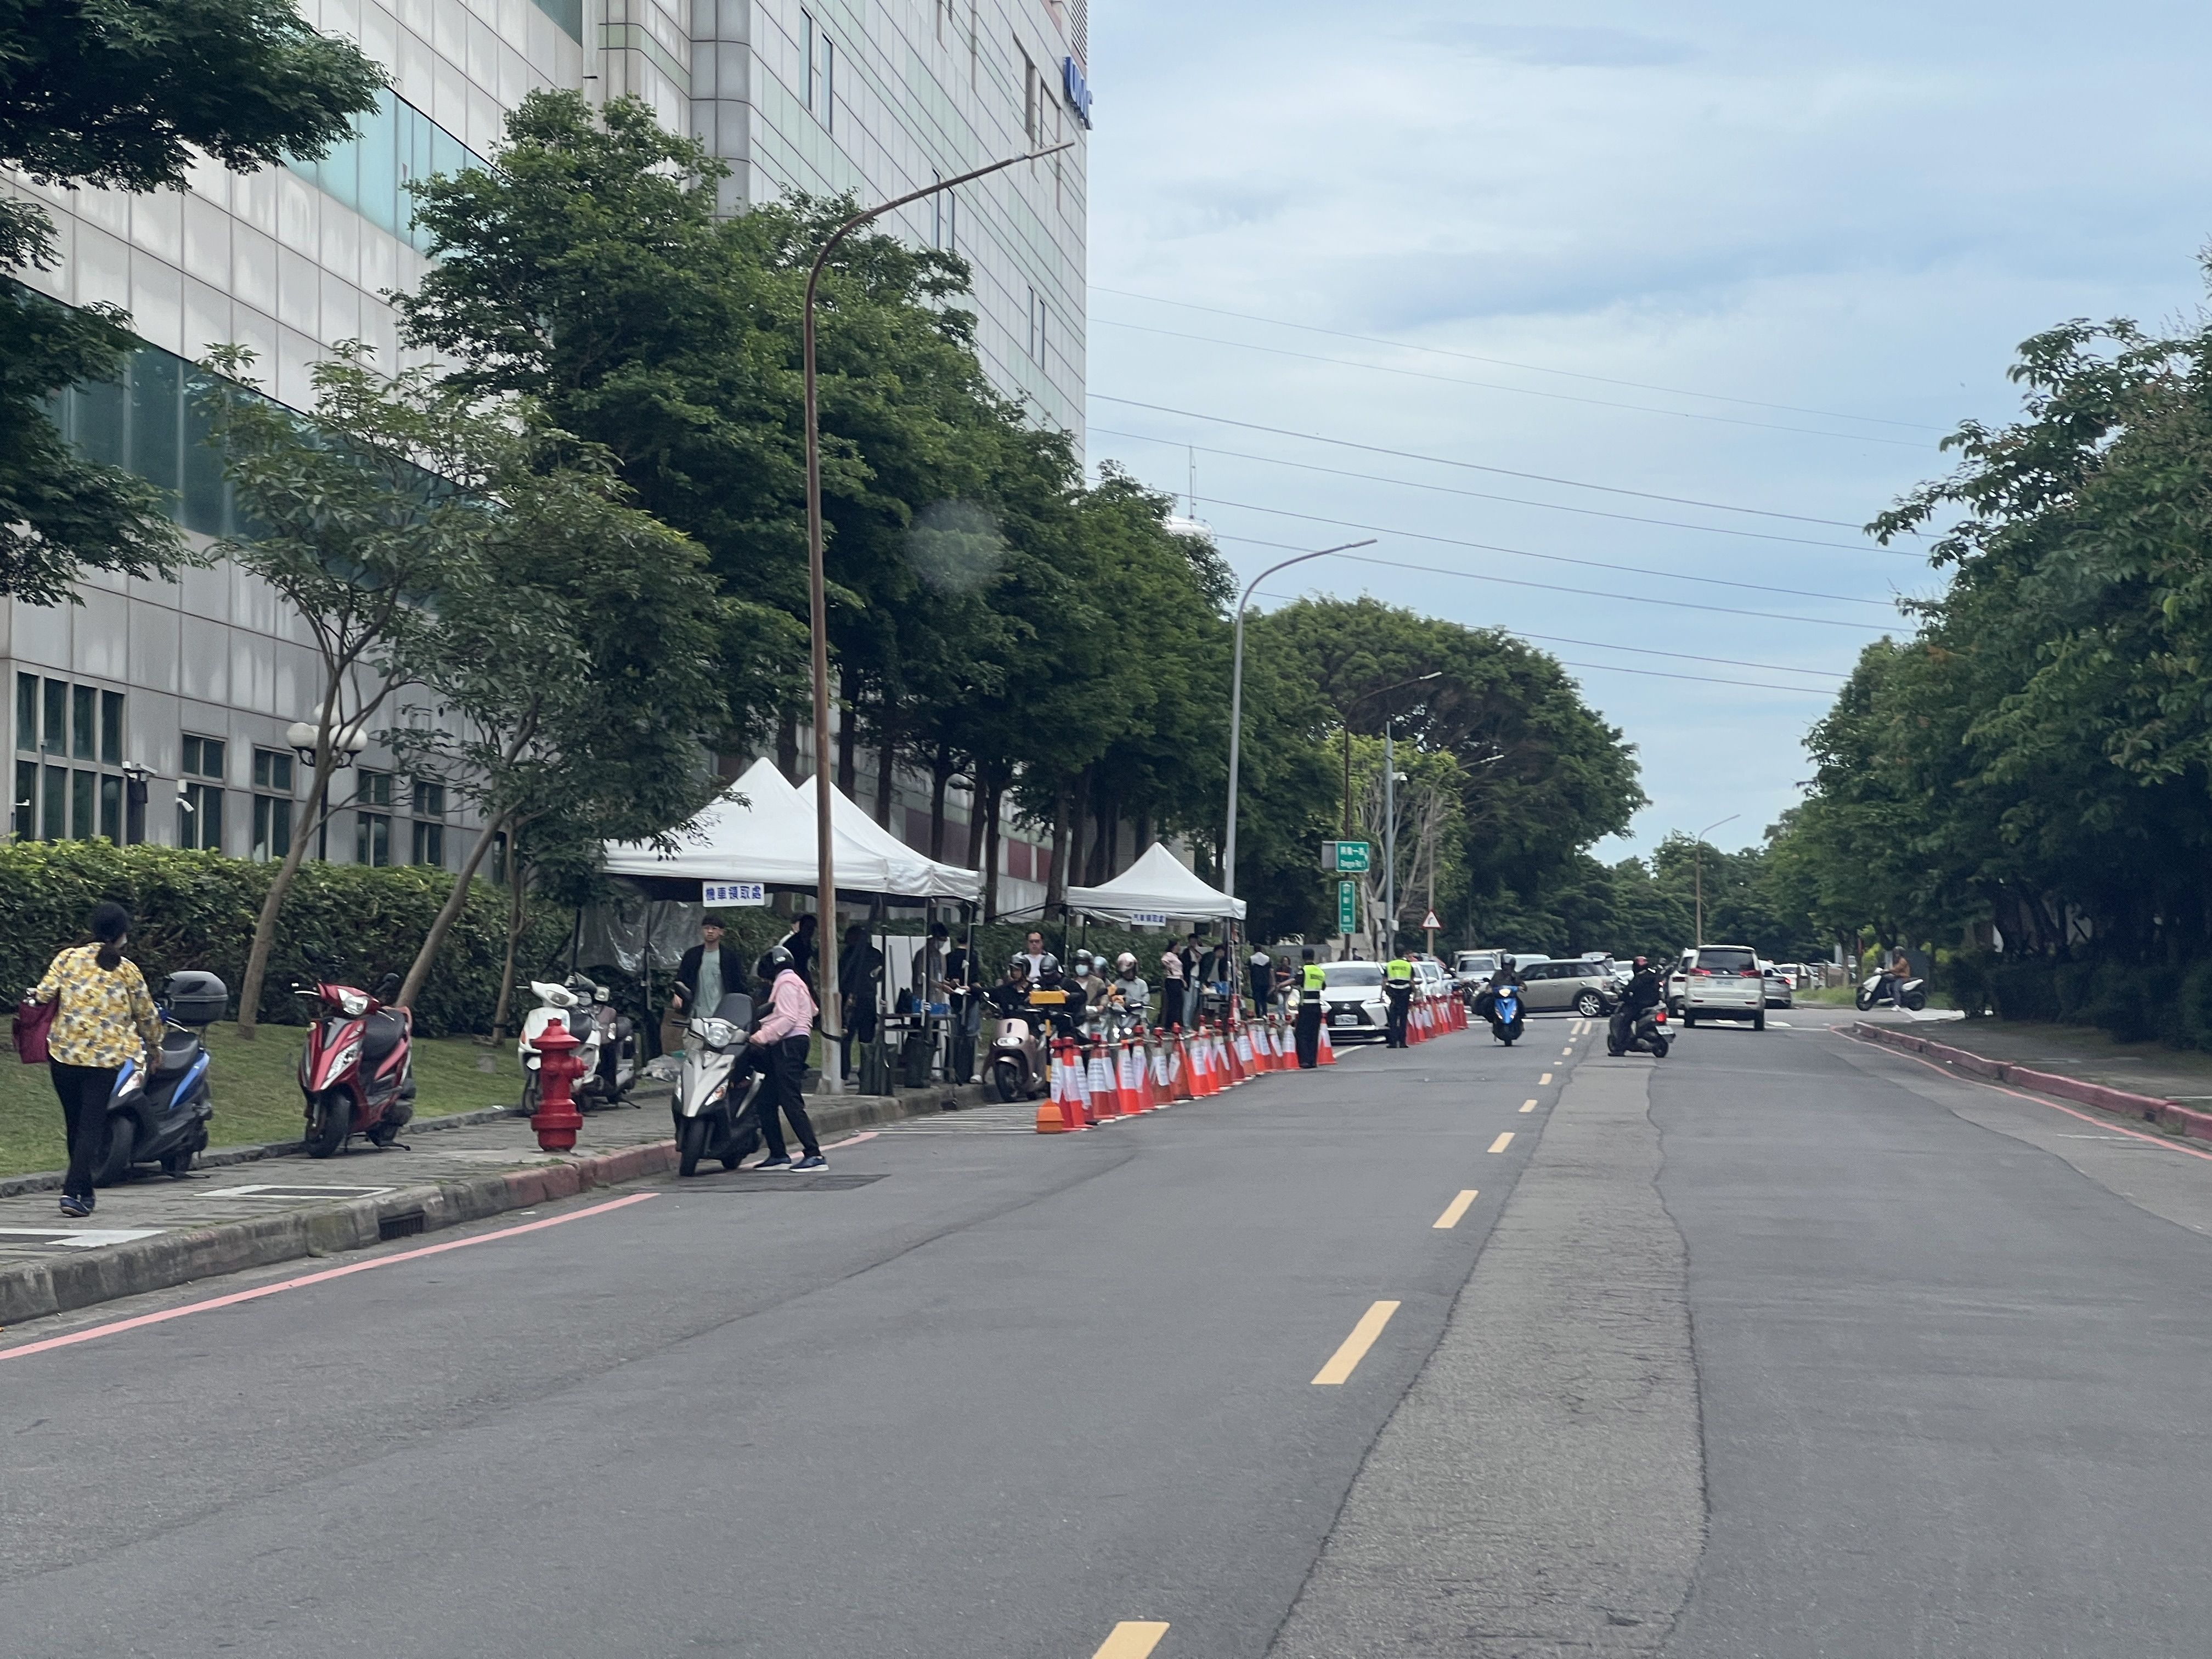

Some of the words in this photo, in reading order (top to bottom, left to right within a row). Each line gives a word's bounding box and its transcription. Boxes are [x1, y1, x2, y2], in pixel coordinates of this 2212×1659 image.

[706, 885, 761, 900] 機車領取處
